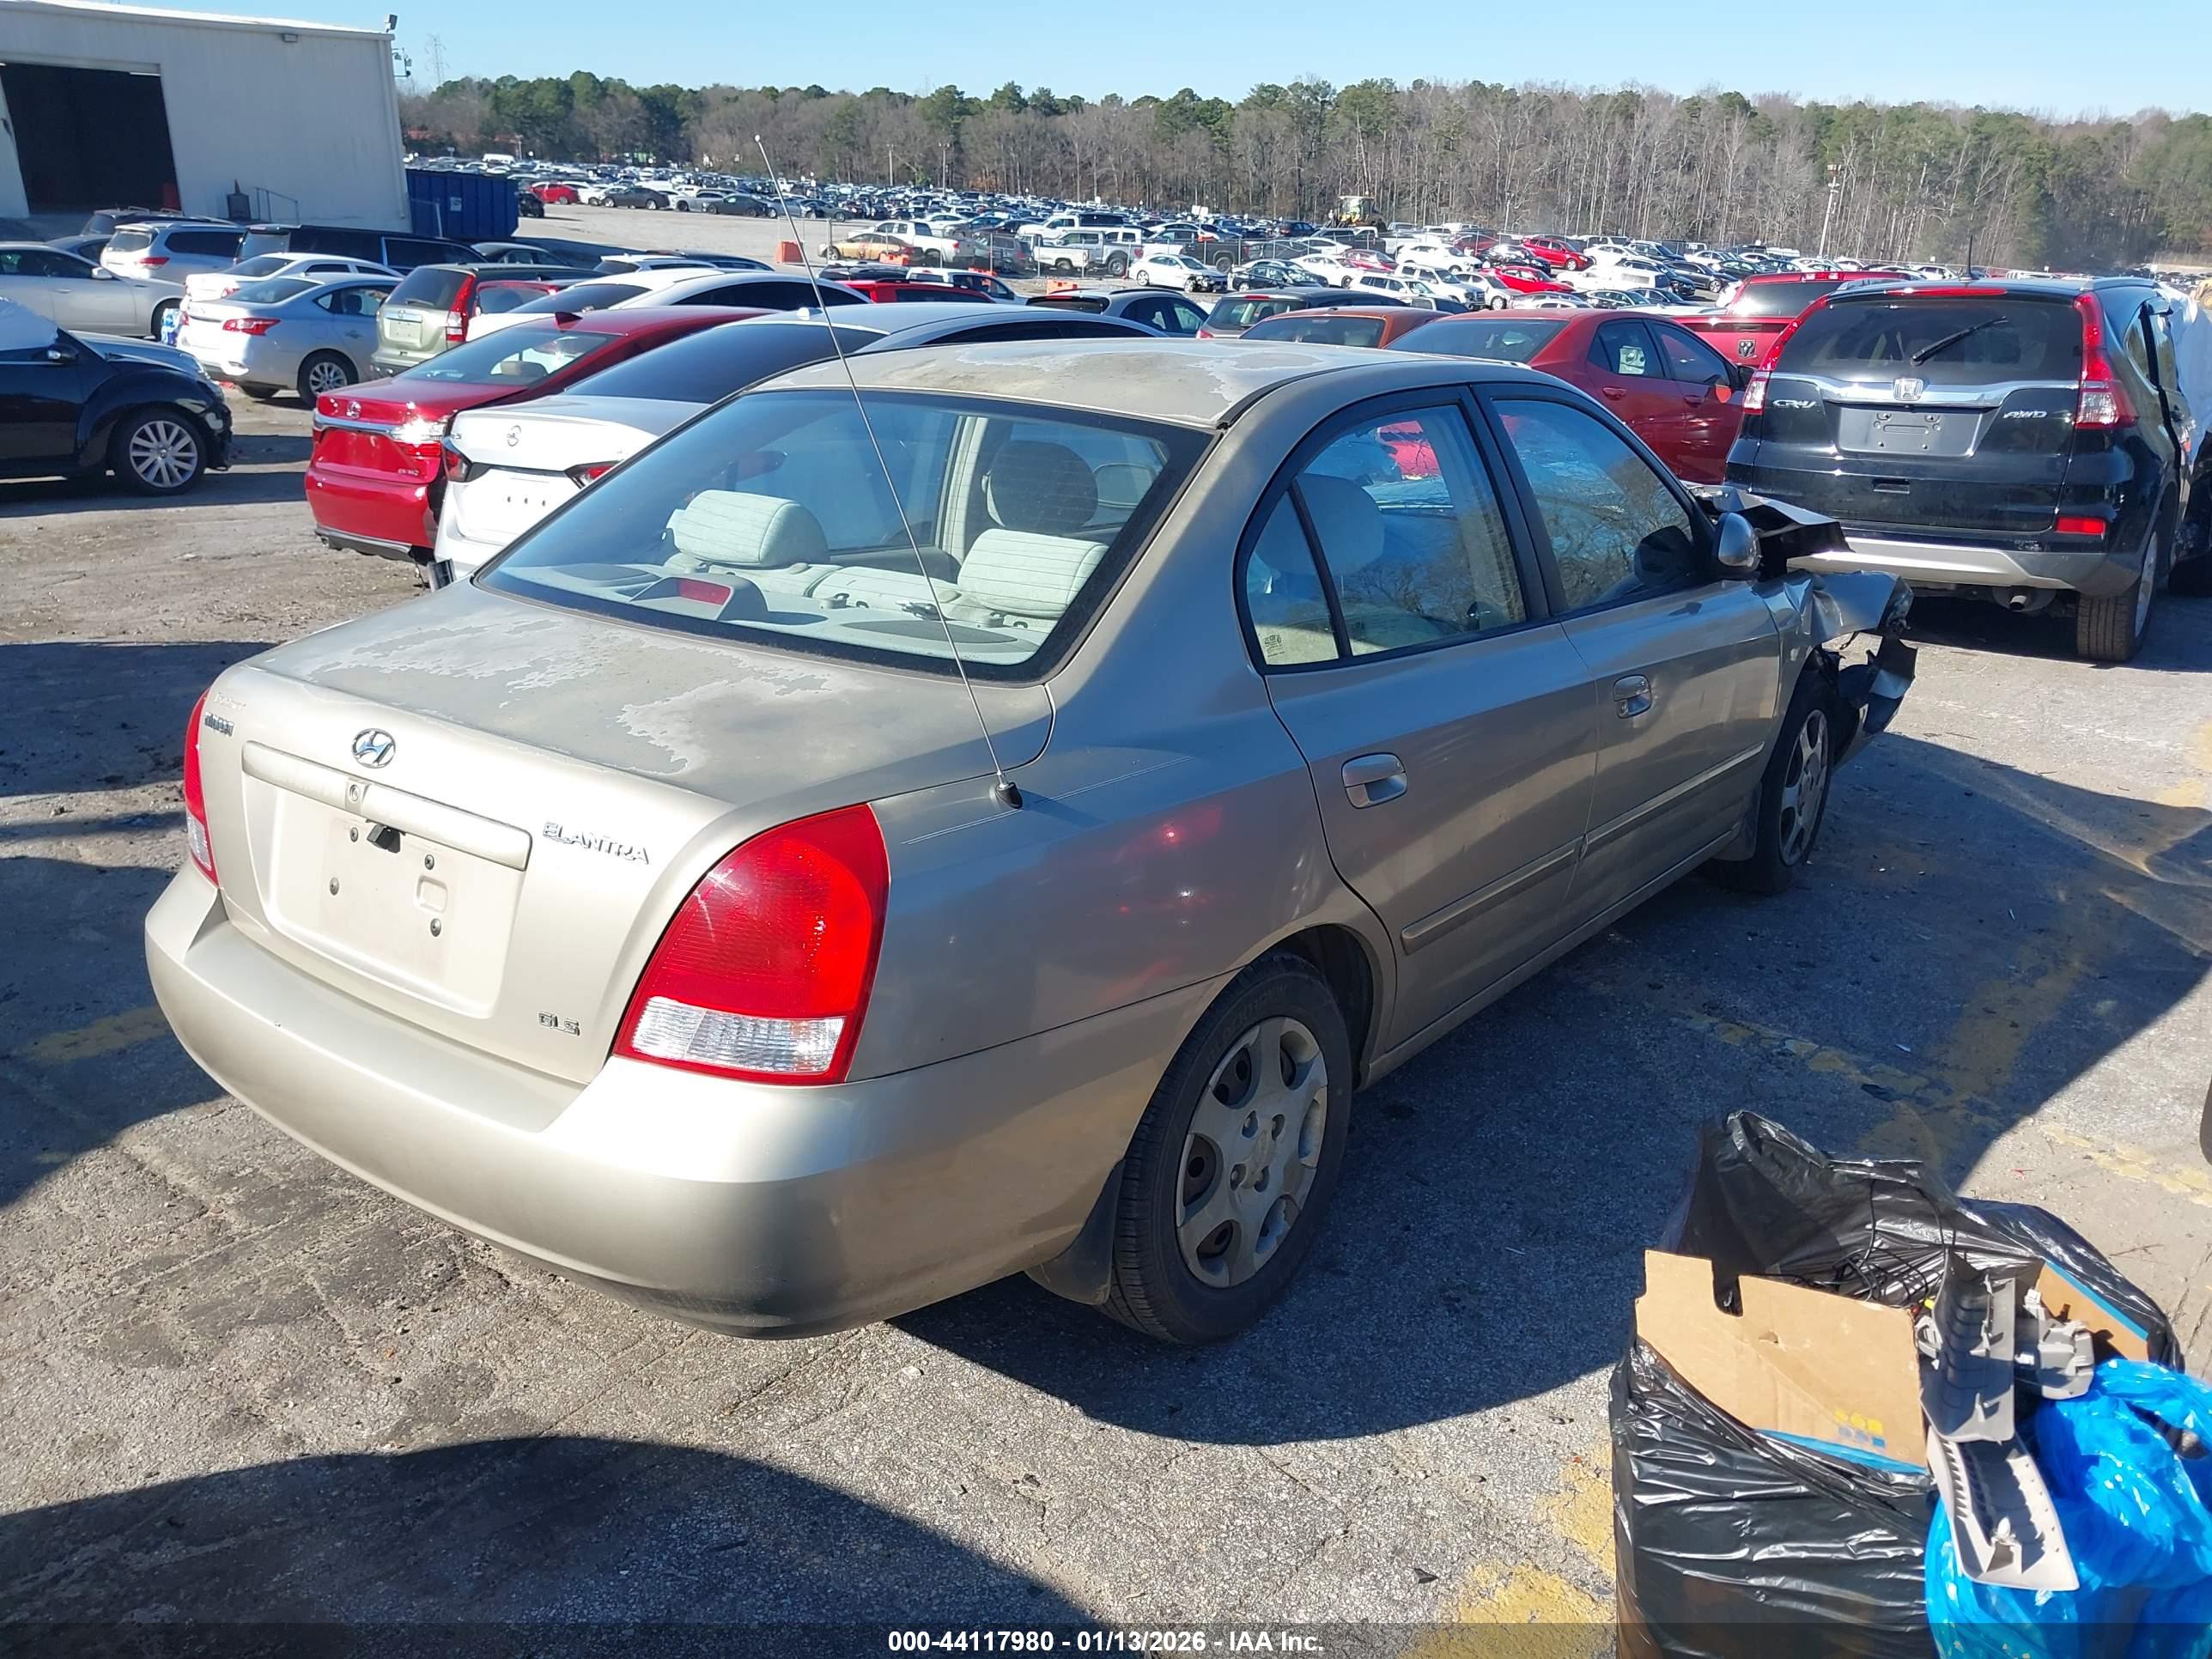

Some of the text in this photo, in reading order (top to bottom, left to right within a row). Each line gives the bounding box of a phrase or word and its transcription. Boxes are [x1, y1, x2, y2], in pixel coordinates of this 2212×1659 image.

[2002, 410, 2048, 419] AWD
[543, 821, 650, 866] ELANTRA
[538, 1011, 580, 1036] GLS
